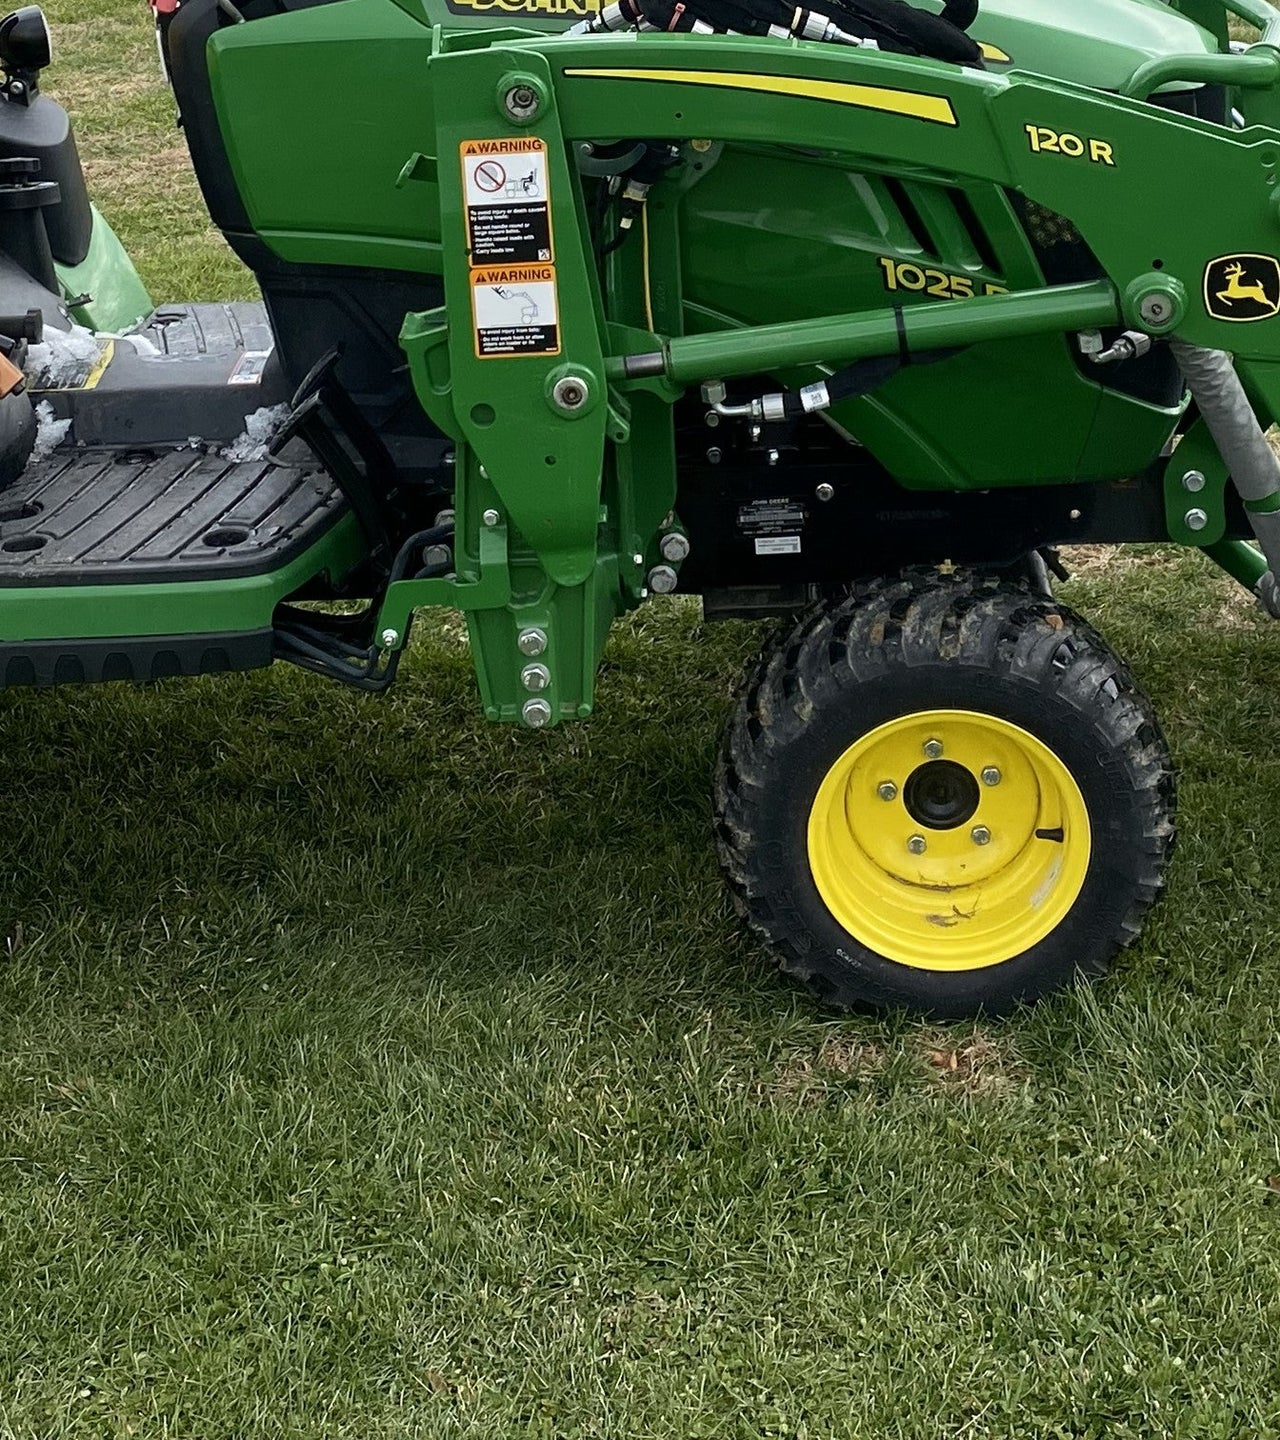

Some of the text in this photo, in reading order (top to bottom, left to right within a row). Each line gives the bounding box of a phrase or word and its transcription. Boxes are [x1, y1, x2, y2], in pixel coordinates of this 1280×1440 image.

[477, 140, 542, 153] WARNING
[1025, 124, 1115, 165] 120 R
[487, 269, 551, 282] WARNING
[880, 257, 975, 300] 1025
